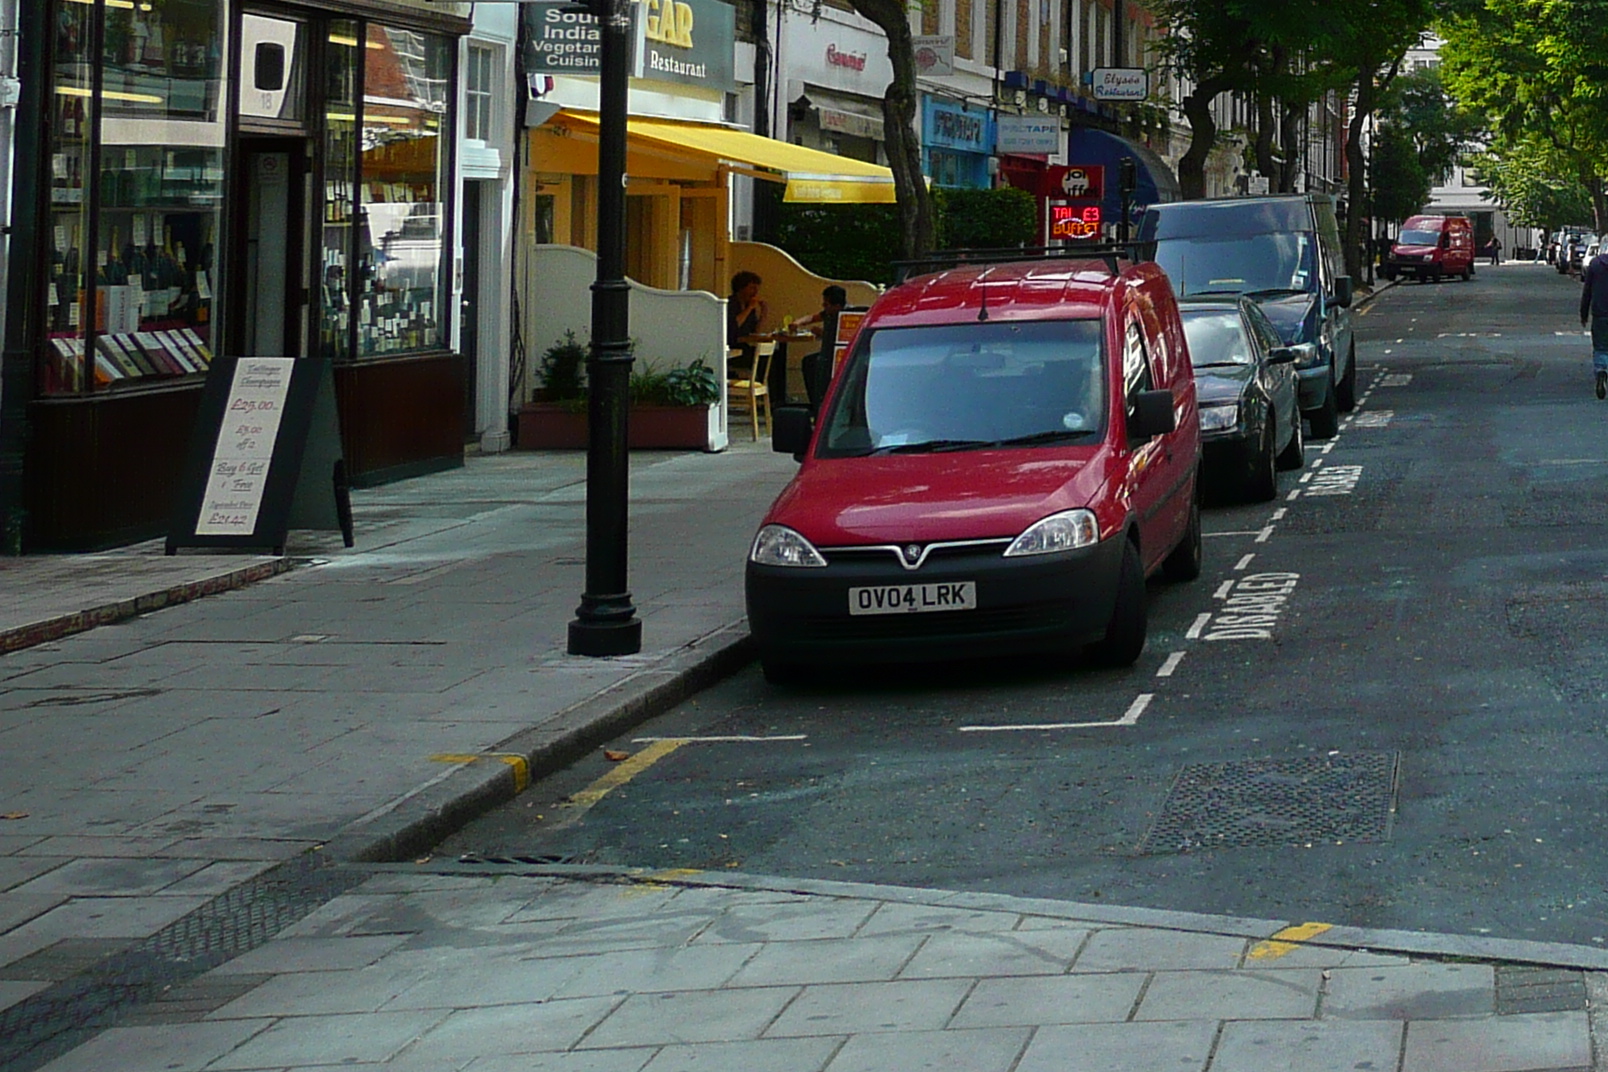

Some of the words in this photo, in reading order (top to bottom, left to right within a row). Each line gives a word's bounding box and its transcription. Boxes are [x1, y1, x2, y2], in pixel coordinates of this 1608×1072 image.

[545, 9, 600, 23] Sou
[544, 26, 600, 40] India
[532, 40, 600, 54] Vegetar
[546, 54, 600, 67] Cuisin
[650, 50, 706, 78] Restaurant
[1096, 85, 1144, 97] Restaurant
[1053, 222, 1100, 235] BUFFET
[859, 587, 915, 609] OV04
[922, 584, 966, 606] LRK
[1203, 571, 1301, 641] DISABLED
